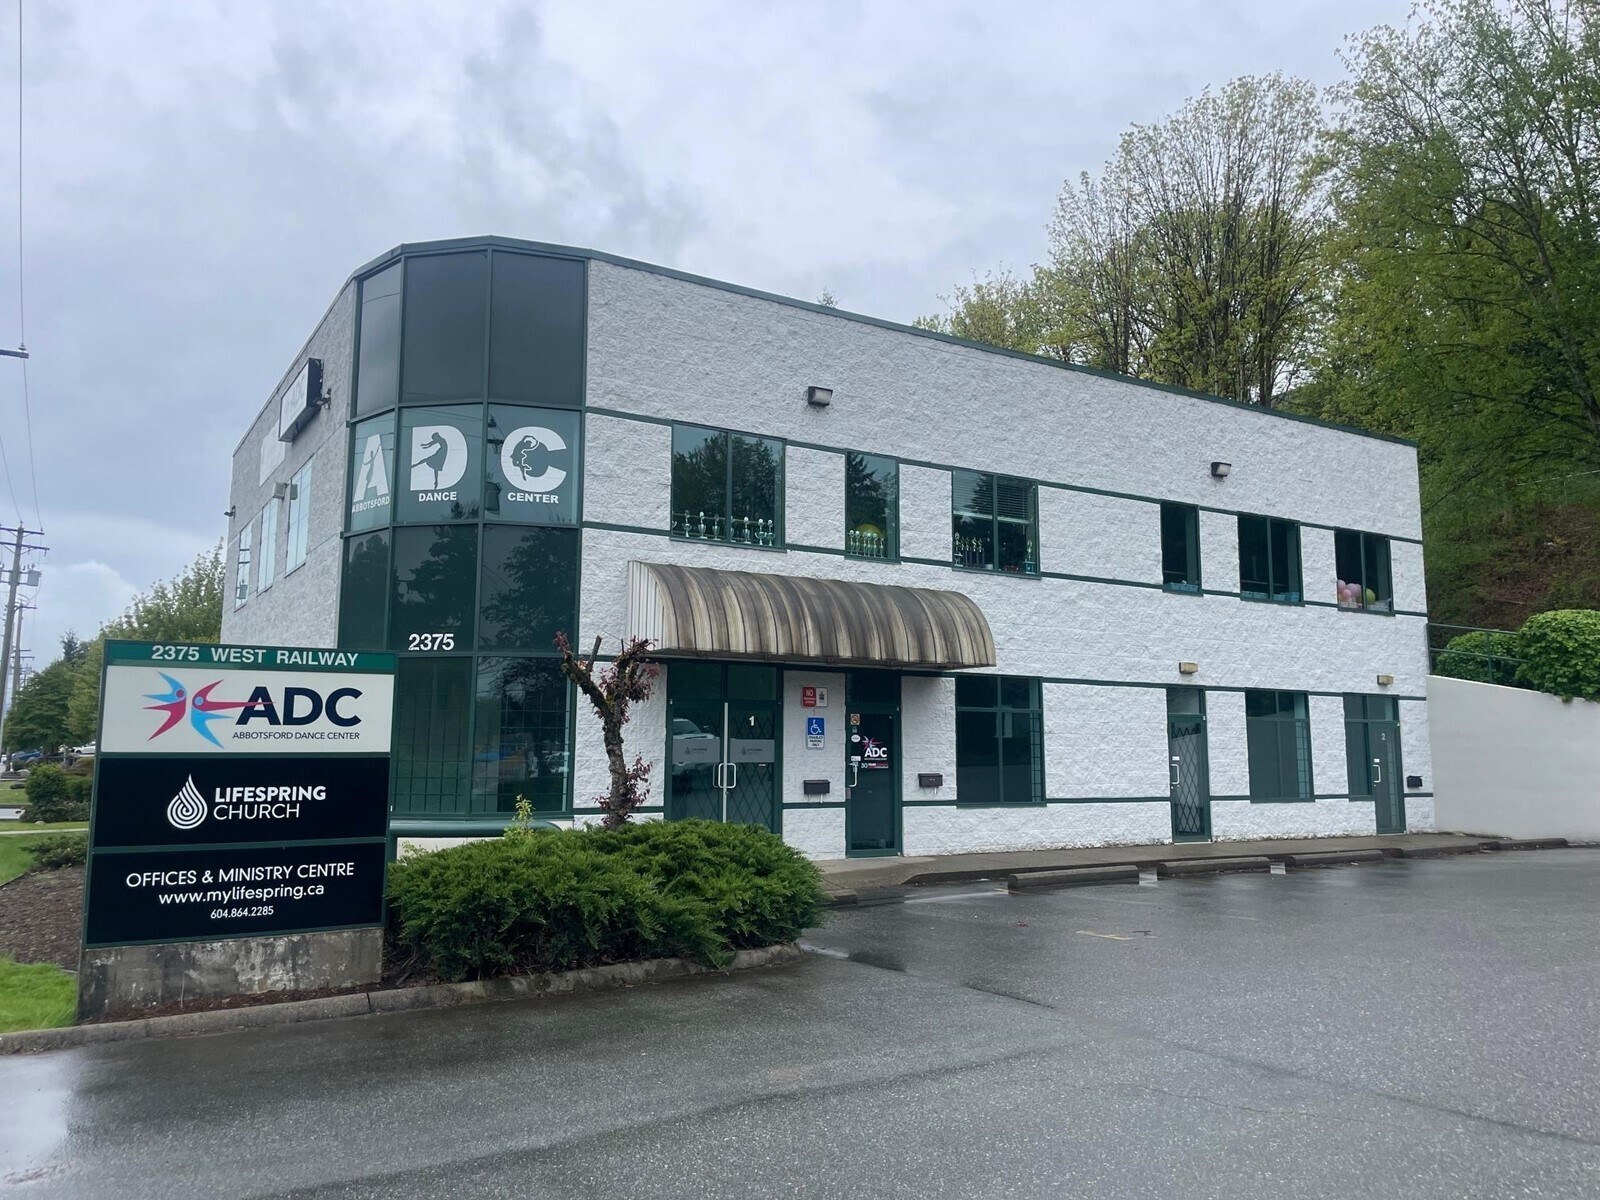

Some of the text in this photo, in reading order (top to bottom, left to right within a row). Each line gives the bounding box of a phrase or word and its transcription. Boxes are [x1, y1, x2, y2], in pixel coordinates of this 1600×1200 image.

[352, 496, 390, 514] ABBOTSFORD
[418, 491, 457, 502] DANCE
[507, 492, 559, 504] CENTER
[408, 633, 455, 651] 2375
[151, 645, 359, 667] 2375 WEST RAILWAY
[235, 686, 363, 727] ADC
[749, 715, 755, 726] 1
[232, 731, 360, 740] ABBOTSFORD DANCE CENTER
[1381, 732, 1386, 741] 2
[864, 747, 888, 758] ADC
[214, 785, 327, 803] LIFESPRING
[213, 803, 300, 820] CHURCH
[126, 862, 355, 887] OFFICES & MINISTRY CENTRE
[158, 884, 325, 905] www.mylifespring.ca
[210, 905, 274, 919] 604.864.2285
